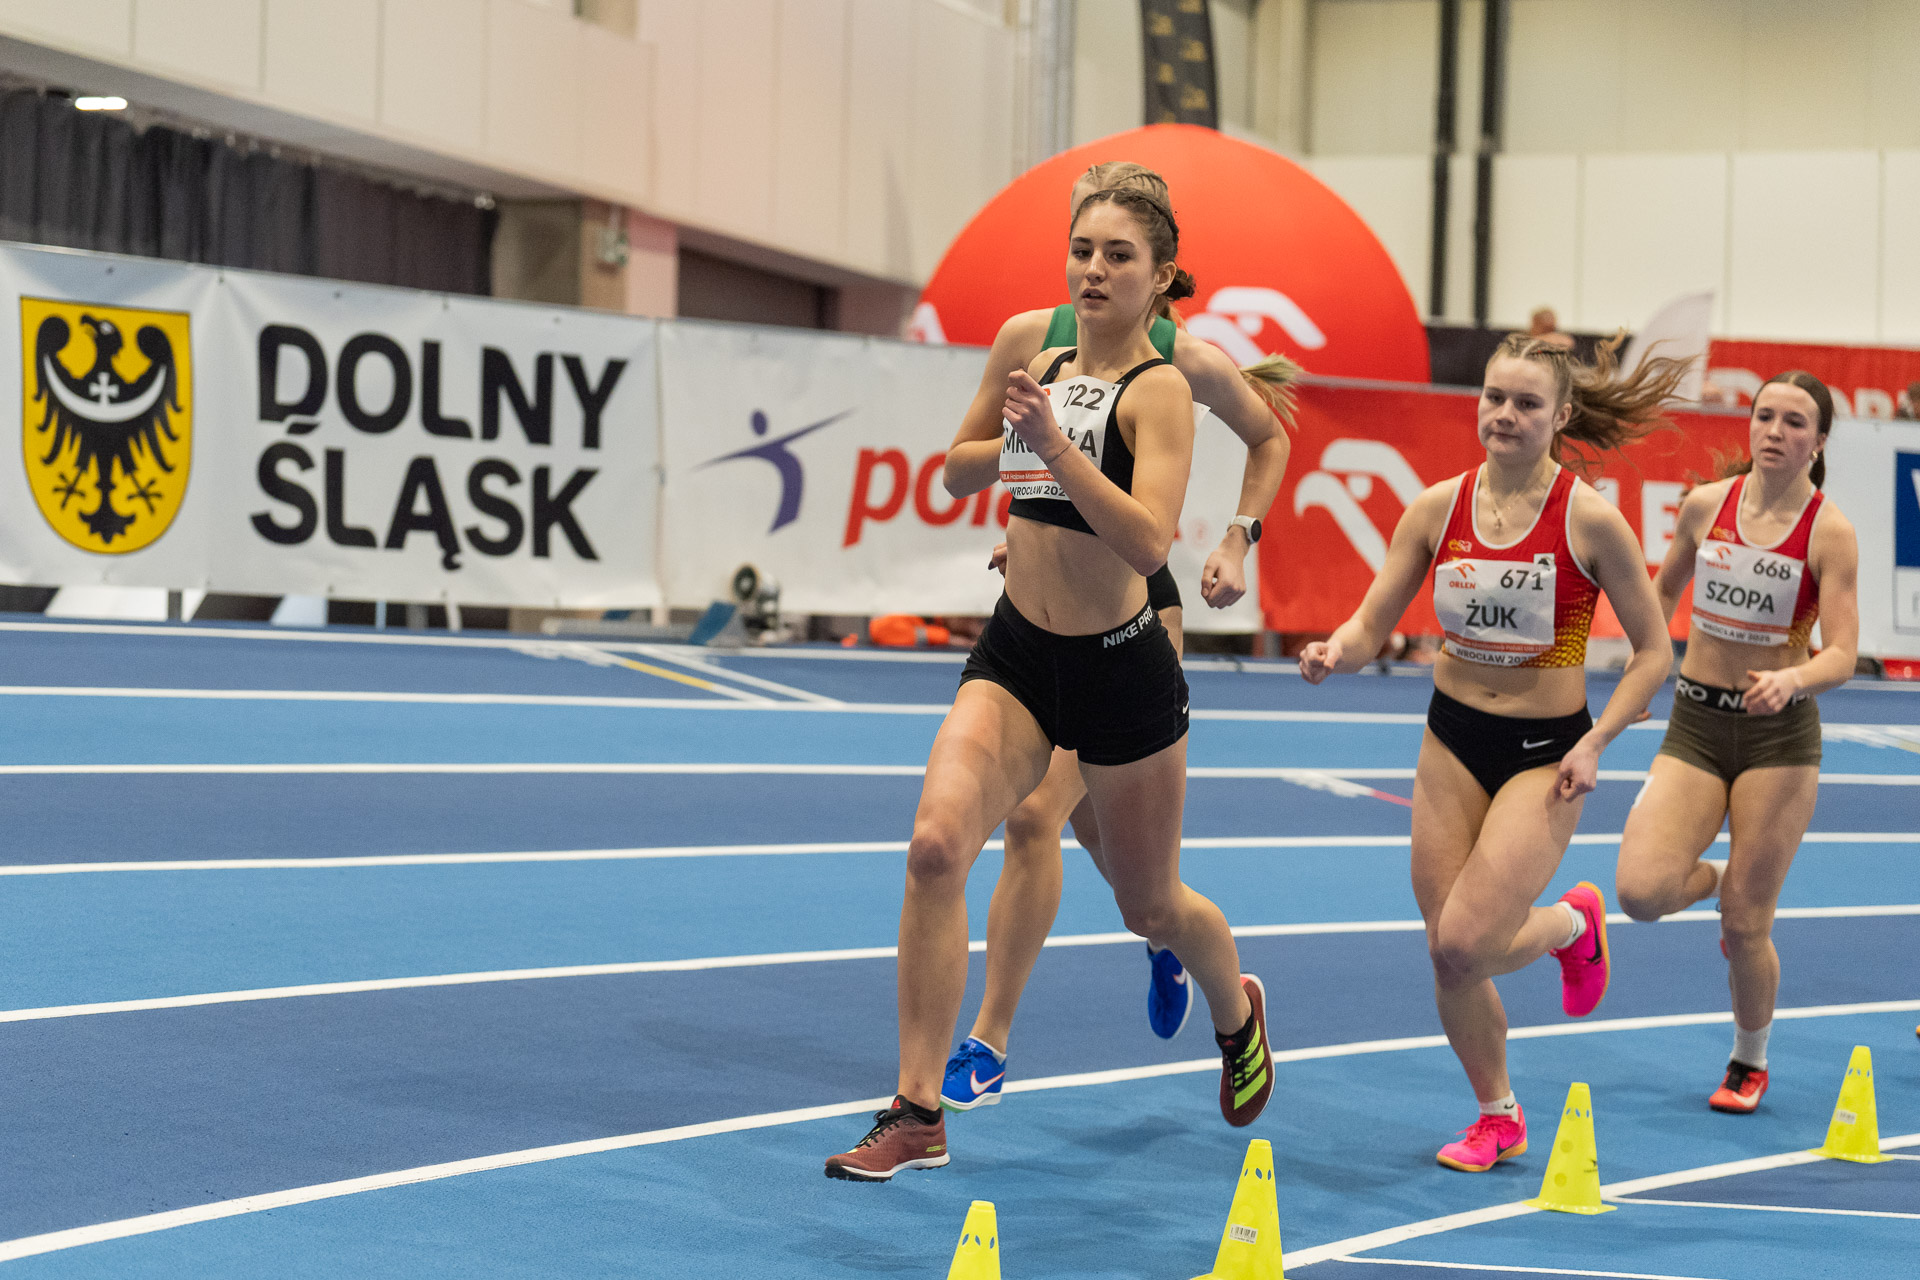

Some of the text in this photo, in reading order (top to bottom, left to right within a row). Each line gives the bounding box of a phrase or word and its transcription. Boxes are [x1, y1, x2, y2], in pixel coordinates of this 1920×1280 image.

[257, 323, 630, 451] DOLNY
[250, 421, 602, 572] ŚLĄSK
[1044, 485, 1066, 497] 202
[1448, 580, 1477, 590] ORLEN
[1499, 568, 1544, 591] 671
[1752, 557, 1791, 581] 668
[1705, 580, 1775, 615] SZOPA
[1103, 605, 1153, 649] NIKE PRO
[1465, 598, 1518, 630] ŻUK
